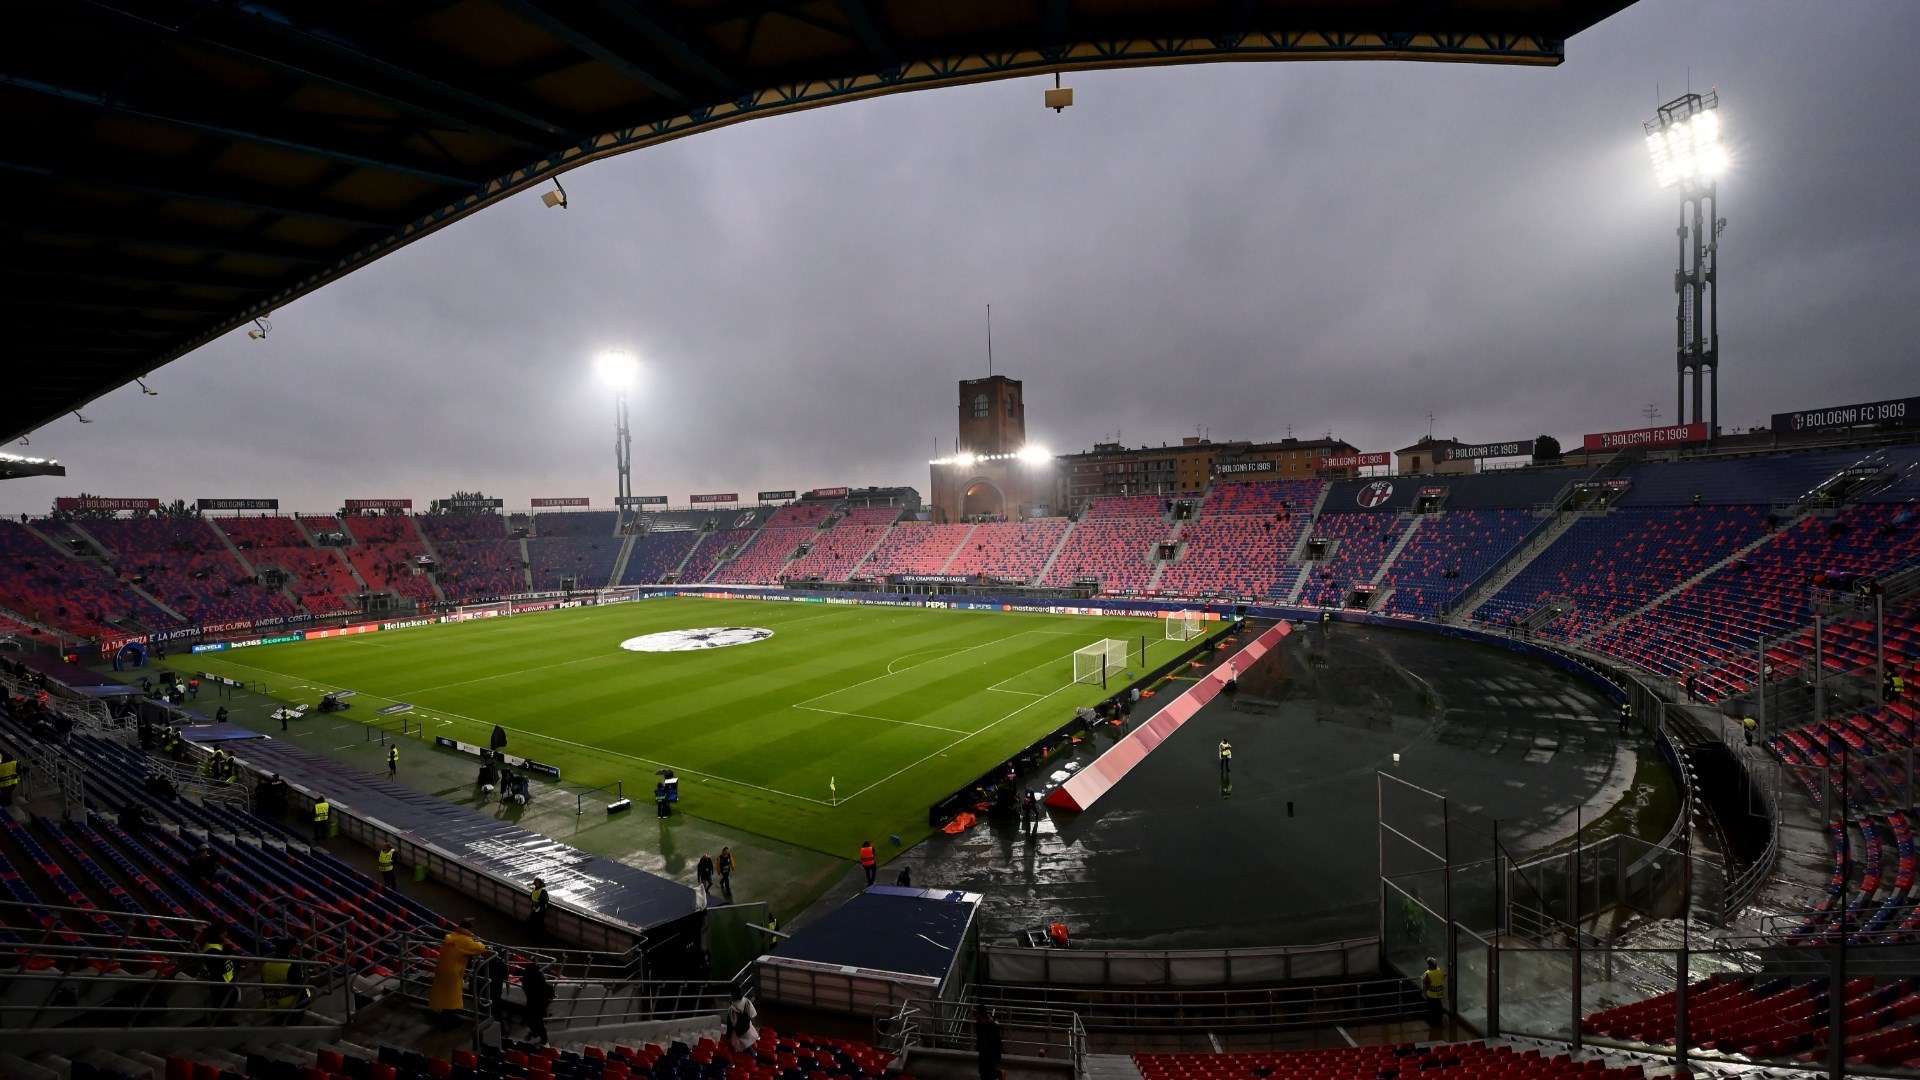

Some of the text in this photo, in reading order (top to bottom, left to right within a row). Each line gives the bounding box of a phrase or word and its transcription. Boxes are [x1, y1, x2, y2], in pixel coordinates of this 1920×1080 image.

[1807, 402, 1905, 427] BOLOGNA FC 1909
[1612, 428, 1688, 446] BOLOGNA FC 1909
[1455, 444, 1518, 458] BOLOGNA FC 1909
[1328, 455, 1383, 467] BOLOGNA FC 1909
[1248, 463, 1256, 471] FC
[86, 500, 119, 509] BOLOGNA
[132, 500, 149, 508] 1909
[521, 605, 546, 613] AIRWAYS
[560, 600, 582, 609] PEPSI
[925, 601, 948, 609] PEPSI
[1012, 604, 1050, 613] mastercard
[1128, 610, 1158, 618] AIRWAYS
[384, 619, 428, 630] Heineken
[101, 642, 110, 652] LA
[149, 634, 155, 642] E
[158, 632, 168, 641] LA
[169, 627, 201, 639] NOSTRA
[202, 623, 224, 633] FEDE
[225, 621, 251, 631] CURVA
[255, 617, 284, 627] ANDREA
[287, 614, 312, 623] COSTA
